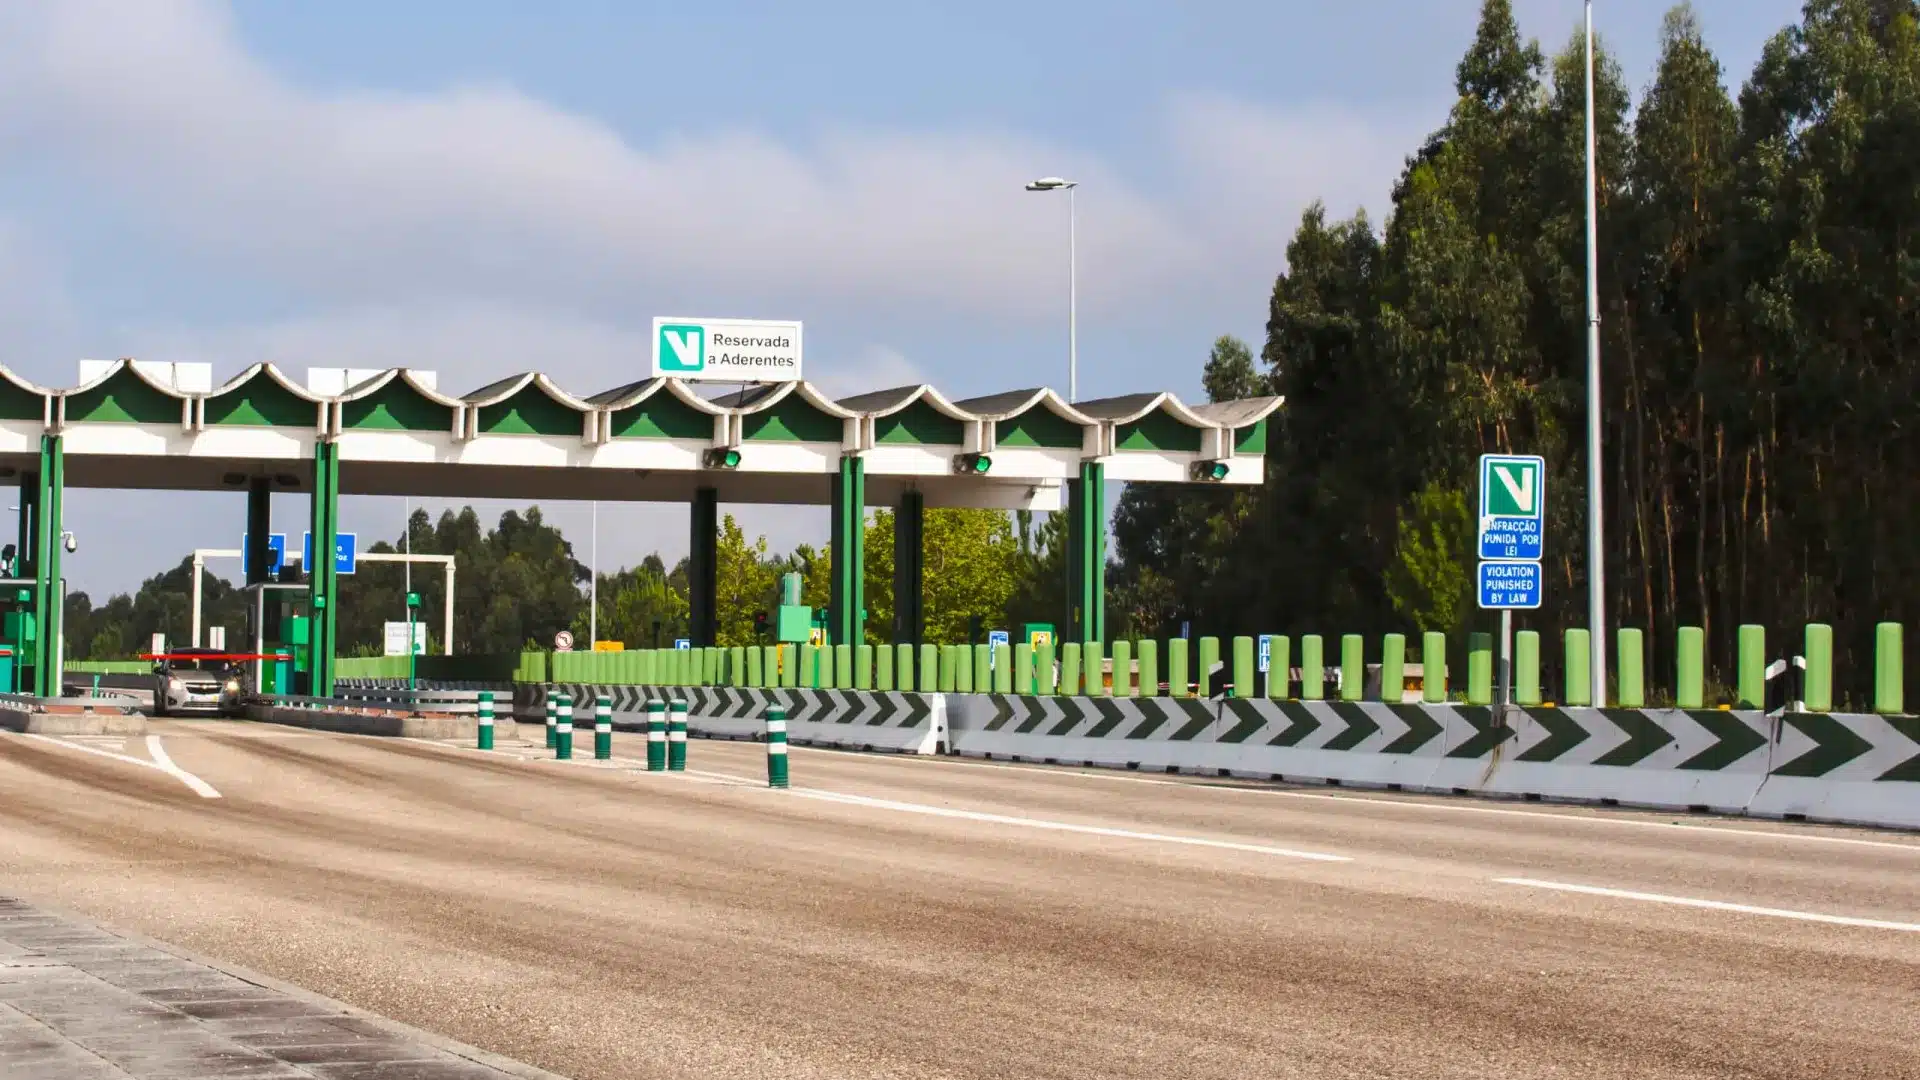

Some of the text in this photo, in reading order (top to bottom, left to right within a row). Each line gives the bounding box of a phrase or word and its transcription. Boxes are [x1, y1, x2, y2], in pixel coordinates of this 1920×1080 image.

[713, 333, 790, 348] Reservada
[708, 352, 794, 367] a Aderentes
[1484, 533, 1540, 545] PUNIDA POR
[1505, 545, 1518, 556] LEI
[1486, 566, 1534, 577] VIOLATION
[1485, 579, 1534, 591] PUNISHED
[1491, 592, 1528, 604] BY LAW
